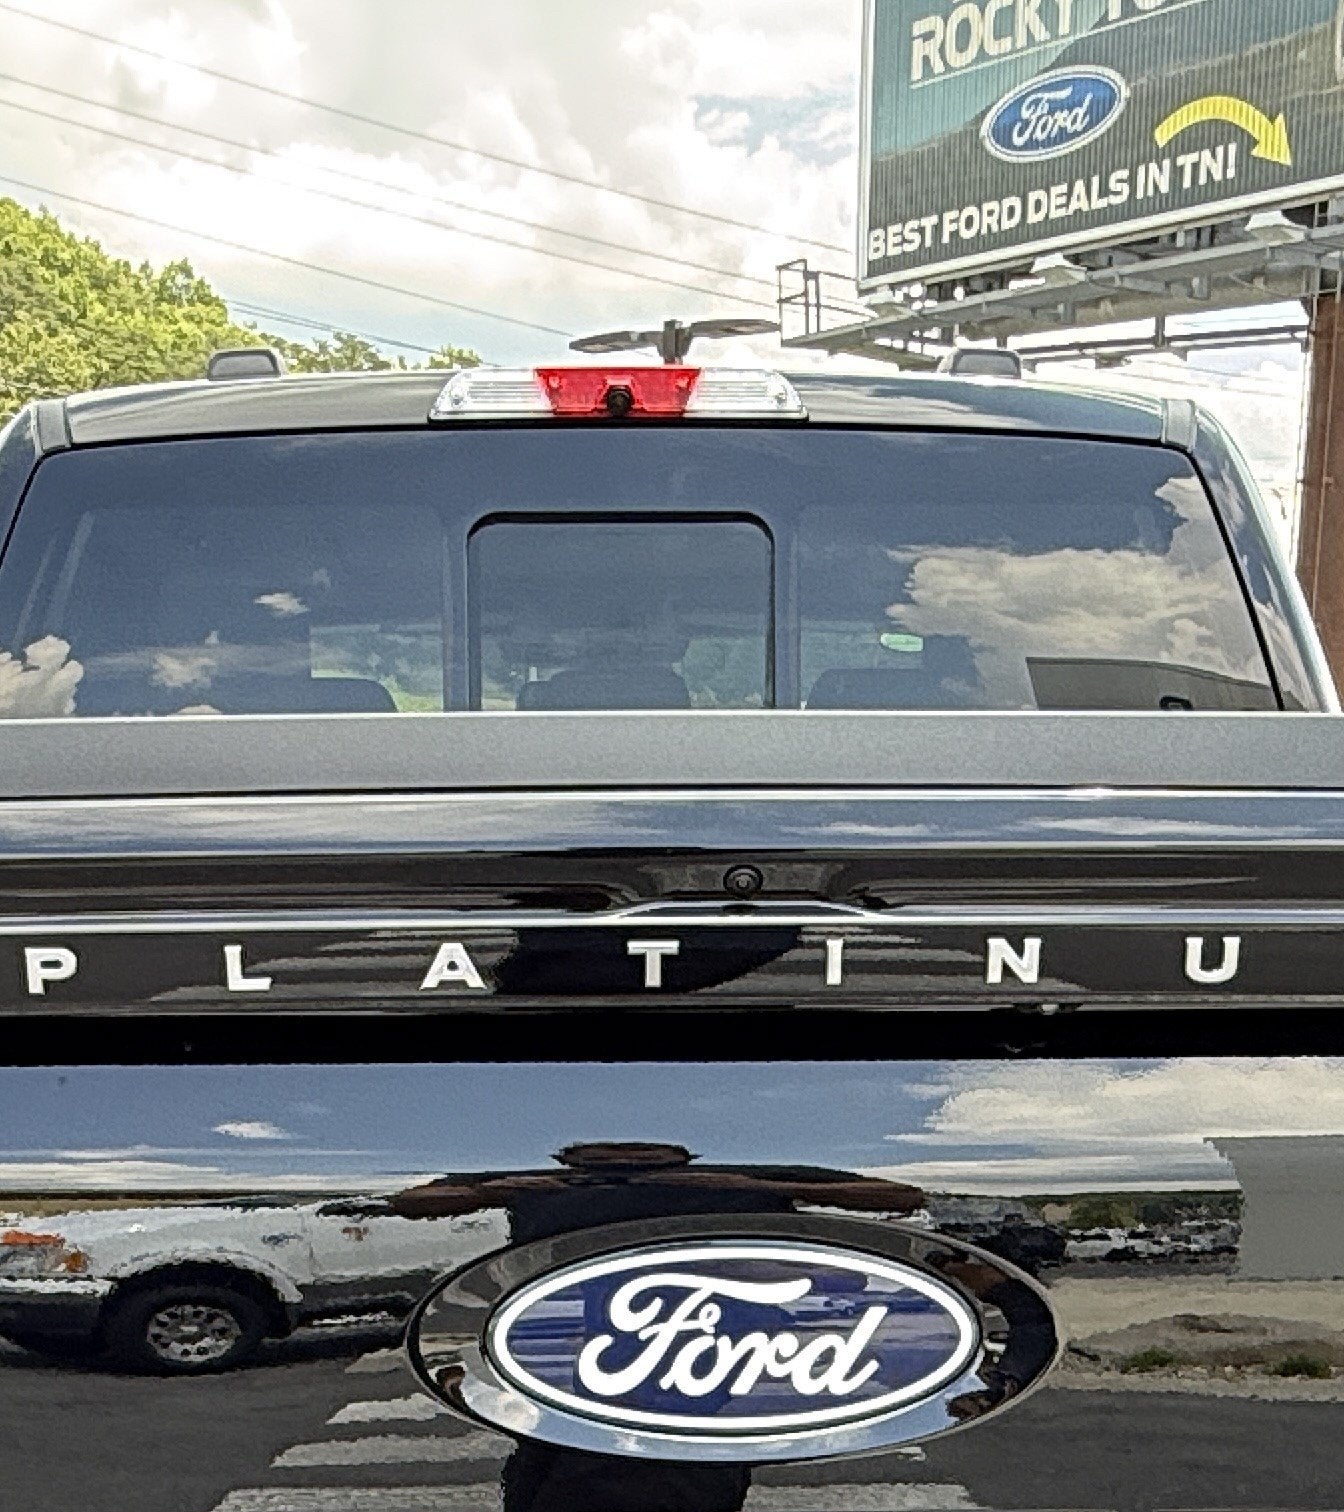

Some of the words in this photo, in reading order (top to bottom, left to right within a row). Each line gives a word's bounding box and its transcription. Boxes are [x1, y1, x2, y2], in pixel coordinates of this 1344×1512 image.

[1013, 86, 1093, 147] Ford
[868, 215, 938, 261] BEST
[941, 197, 1022, 245] FORD
[1027, 169, 1130, 224] DEALS
[1136, 158, 1171, 200] IN
[1176, 143, 1237, 189] TN!
[578, 1272, 888, 1397] Ford
